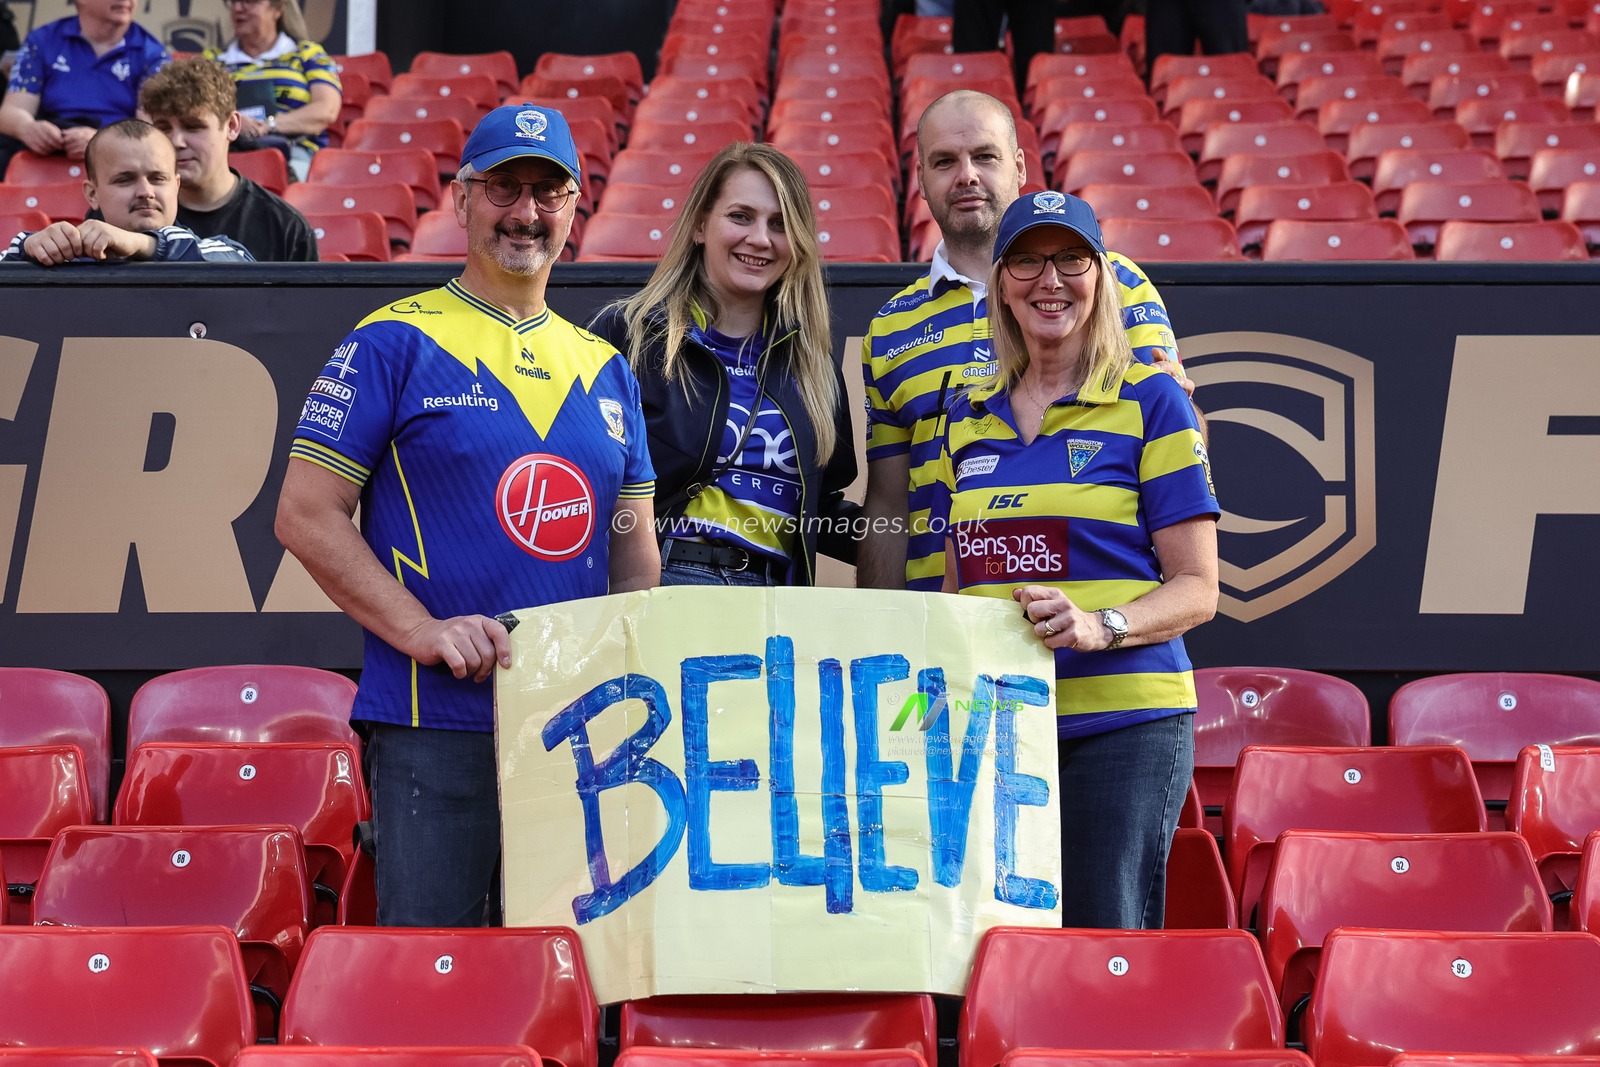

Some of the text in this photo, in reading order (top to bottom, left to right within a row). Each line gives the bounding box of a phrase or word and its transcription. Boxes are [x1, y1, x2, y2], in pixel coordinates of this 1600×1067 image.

[886, 330, 943, 361] Resulting
[515, 365, 551, 380] oneills
[311, 380, 352, 400] ETFRED
[310, 400, 344, 422] SUPER
[423, 393, 498, 411] Resulting
[306, 411, 340, 431] LEAGUE
[962, 465, 994, 475] Chester
[964, 457, 990, 467] University
[987, 493, 1029, 510] ISC
[956, 533, 1047, 559] Bensons
[985, 548, 1063, 575] for beds
[541, 634, 1060, 926] BELIEVE
